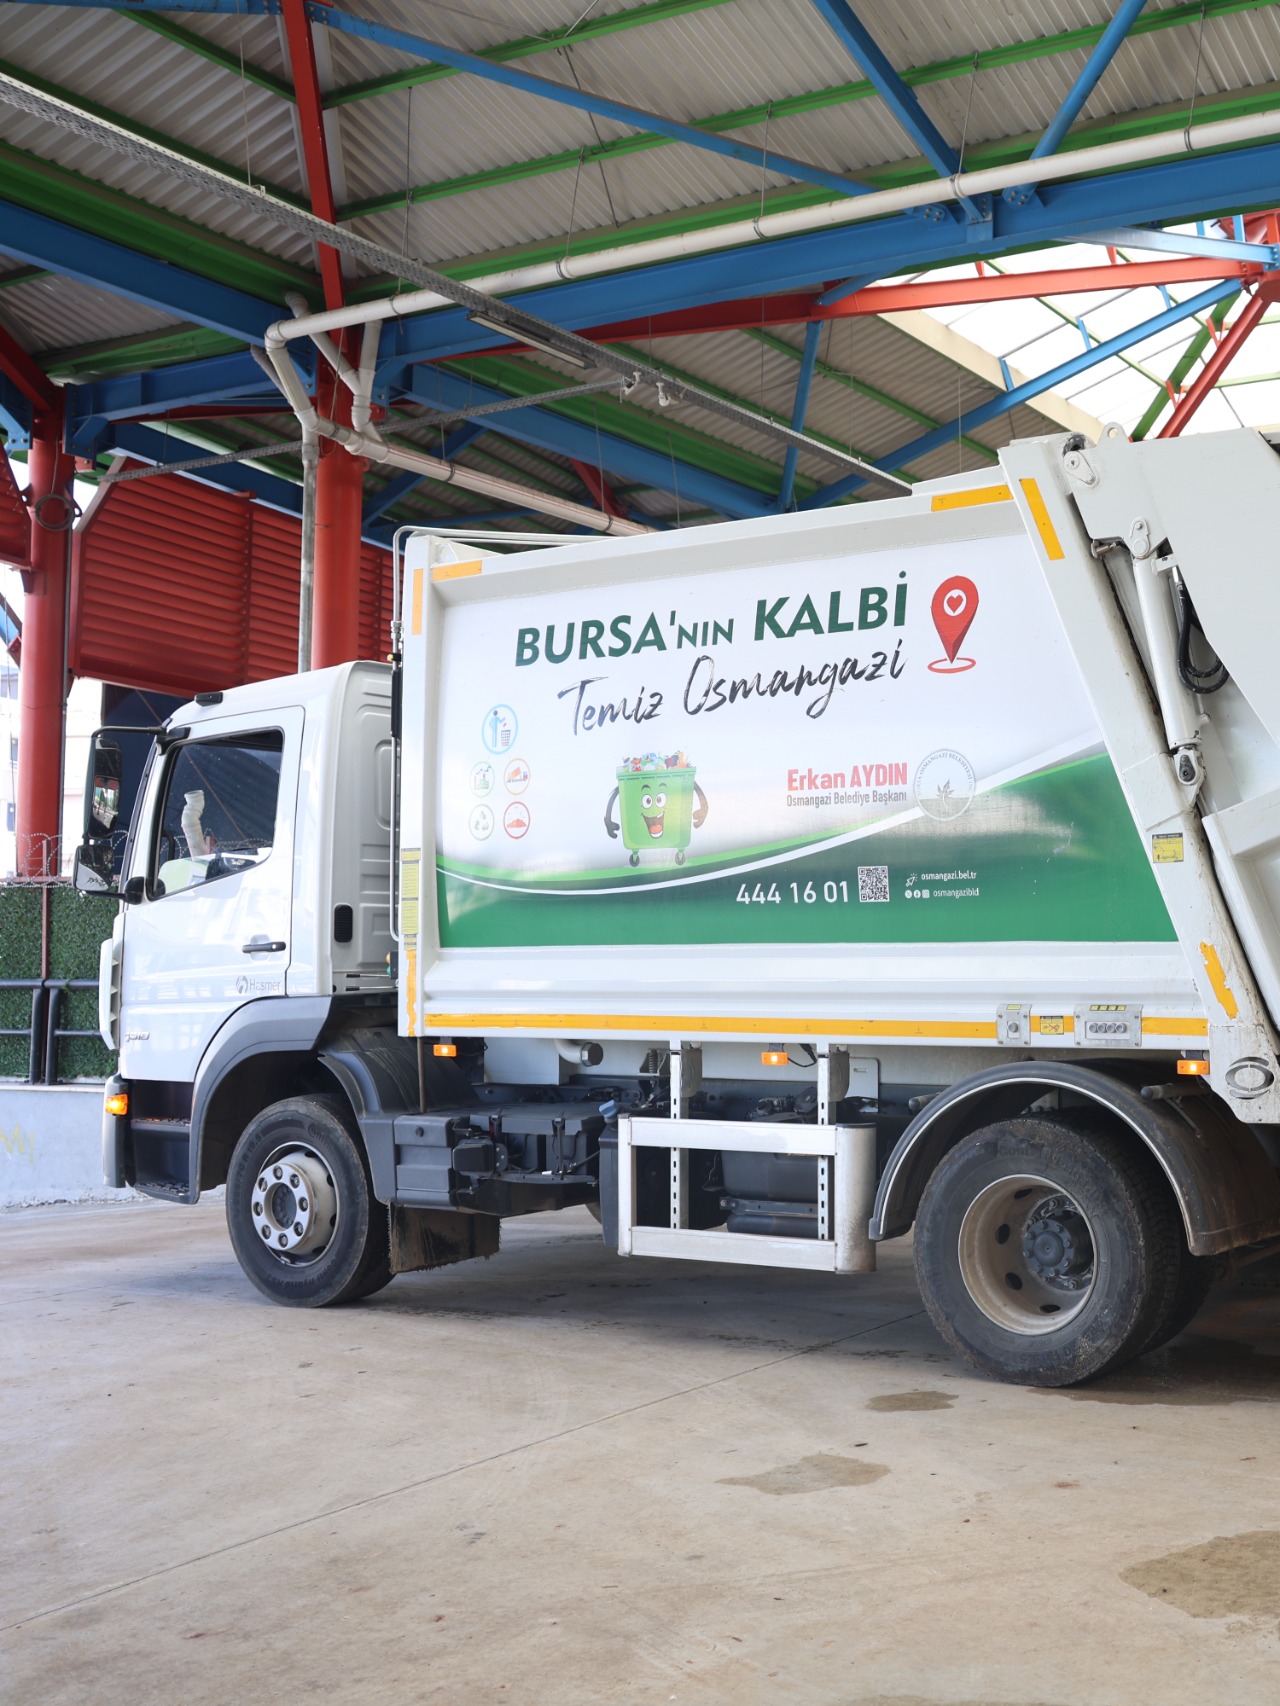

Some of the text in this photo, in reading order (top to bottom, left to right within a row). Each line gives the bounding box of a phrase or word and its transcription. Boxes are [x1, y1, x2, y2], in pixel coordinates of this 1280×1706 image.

[515, 570, 908, 667] BURSA'NIN KALBİ
[557, 638, 909, 736] Temiz Osmangazi
[788, 762, 908, 791] Erkan AYDIN
[786, 789, 907, 808] Osmangazi Belediye Başkanı
[736, 881, 849, 904] 444 16 01
[249, 978, 281, 991] Hasmer
